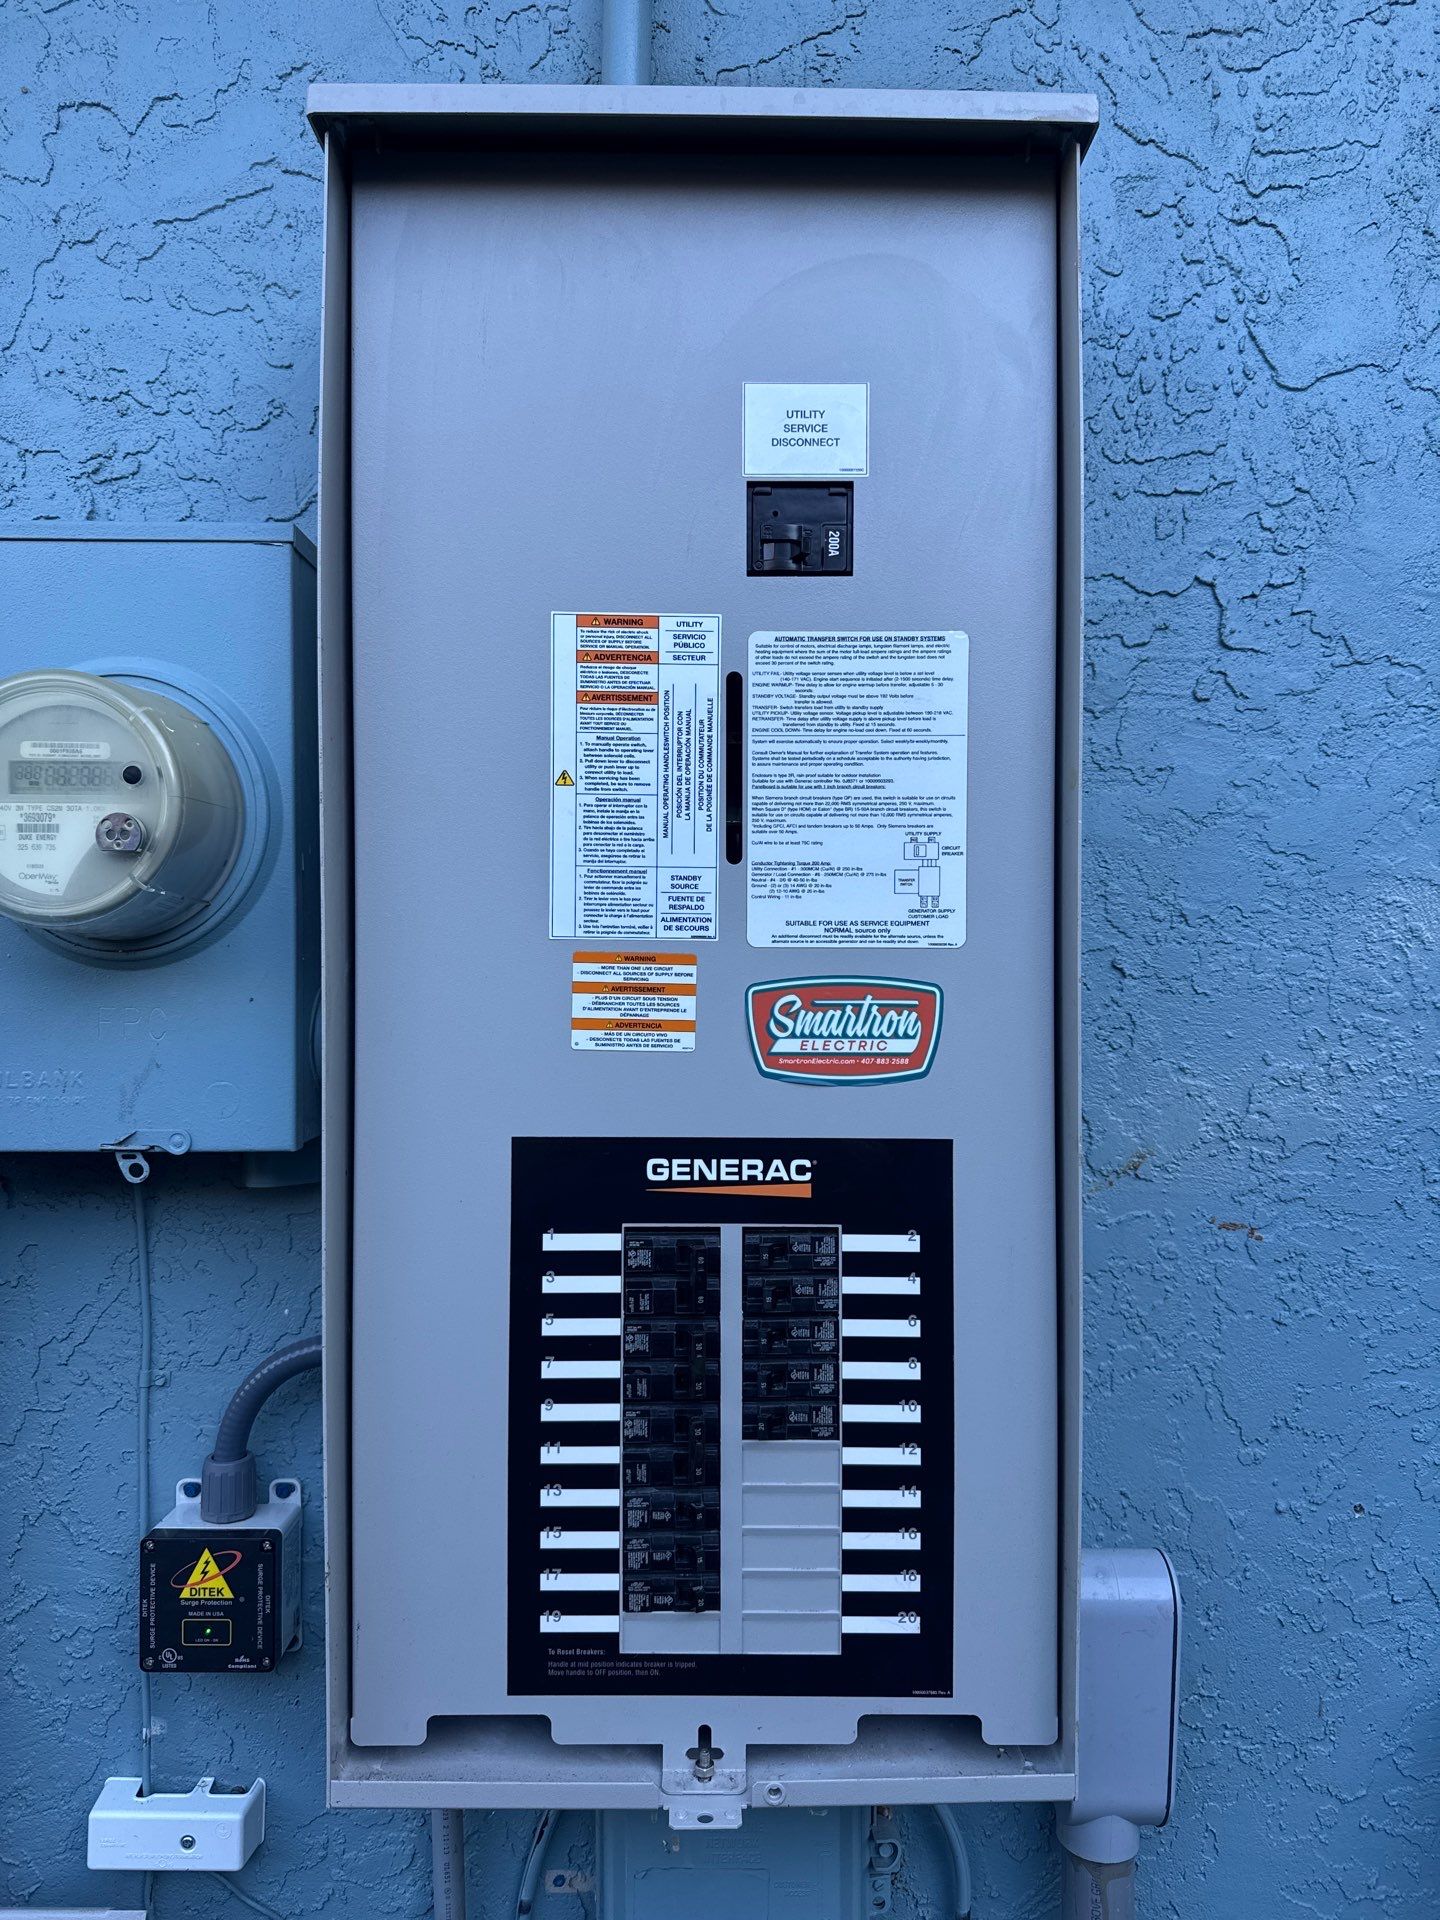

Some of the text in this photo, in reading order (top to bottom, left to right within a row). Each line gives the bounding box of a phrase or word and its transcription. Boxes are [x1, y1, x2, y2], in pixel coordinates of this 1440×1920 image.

[786, 410, 826, 419] UTILITY
[783, 424, 828, 433] SERVICE
[772, 438, 840, 447] DISCONNECT
[828, 530, 840, 556] 200A
[604, 618, 644, 626] WARNING
[673, 641, 706, 649] PÚBLICO
[594, 654, 652, 662] ADVERTENCIA
[672, 654, 706, 662] SECTEUR
[592, 694, 653, 702] AVERTISSEMENT
[698, 770, 704, 779] DU
[706, 774, 712, 782] DE
[685, 777, 691, 785] DE
[685, 812, 691, 820] LA
[706, 814, 712, 822] LA
[706, 823, 712, 832] DE
[768, 994, 922, 1038] Smartron
[800, 1040, 888, 1051] ELECTRIC
[0, 1071, 83, 1089] LBANK
[646, 1158, 812, 1182] GENERAC
[547, 1228, 554, 1240] 1
[908, 1230, 917, 1242] 2
[546, 1270, 555, 1283] 3
[907, 1272, 917, 1284] 4
[545, 1313, 554, 1326] 5
[908, 1314, 917, 1327] 6
[545, 1356, 555, 1368] 7
[908, 1357, 918, 1370] 8
[544, 1398, 554, 1411] 9
[899, 1400, 918, 1412] 10
[544, 1441, 561, 1454] 11
[899, 1443, 918, 1455] 12
[544, 1484, 562, 1497] 13
[899, 1486, 917, 1498] 14
[543, 1526, 562, 1539] 15
[899, 1528, 917, 1540] 16
[543, 1568, 562, 1581] 17
[900, 1569, 917, 1582] 18
[189, 1587, 225, 1597] DITEK
[543, 1610, 562, 1623] 19
[898, 1612, 917, 1624] 20
[166, 1651, 174, 1660] UL
